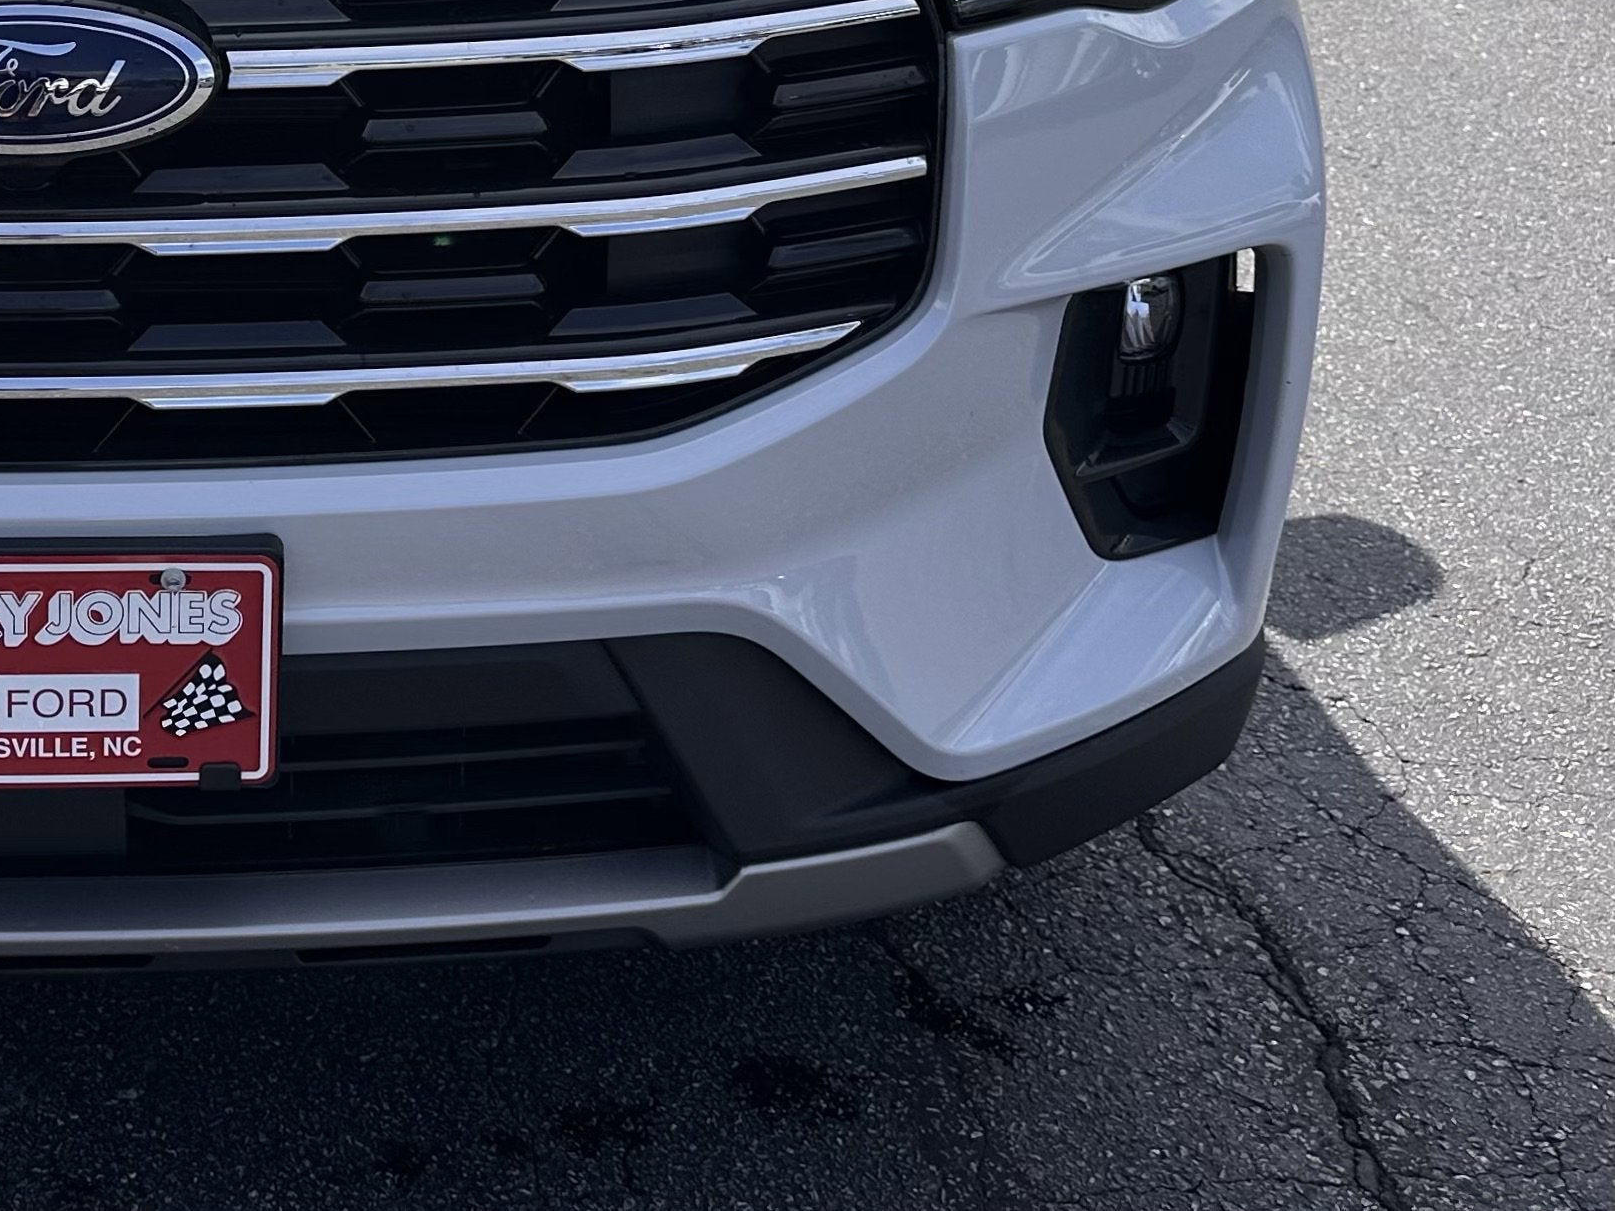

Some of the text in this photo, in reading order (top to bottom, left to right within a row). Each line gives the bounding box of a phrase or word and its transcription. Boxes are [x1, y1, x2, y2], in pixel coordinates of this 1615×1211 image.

[34, 588, 243, 647] JONES
[6, 688, 128, 719] FORD
[103, 736, 143, 758] NC
